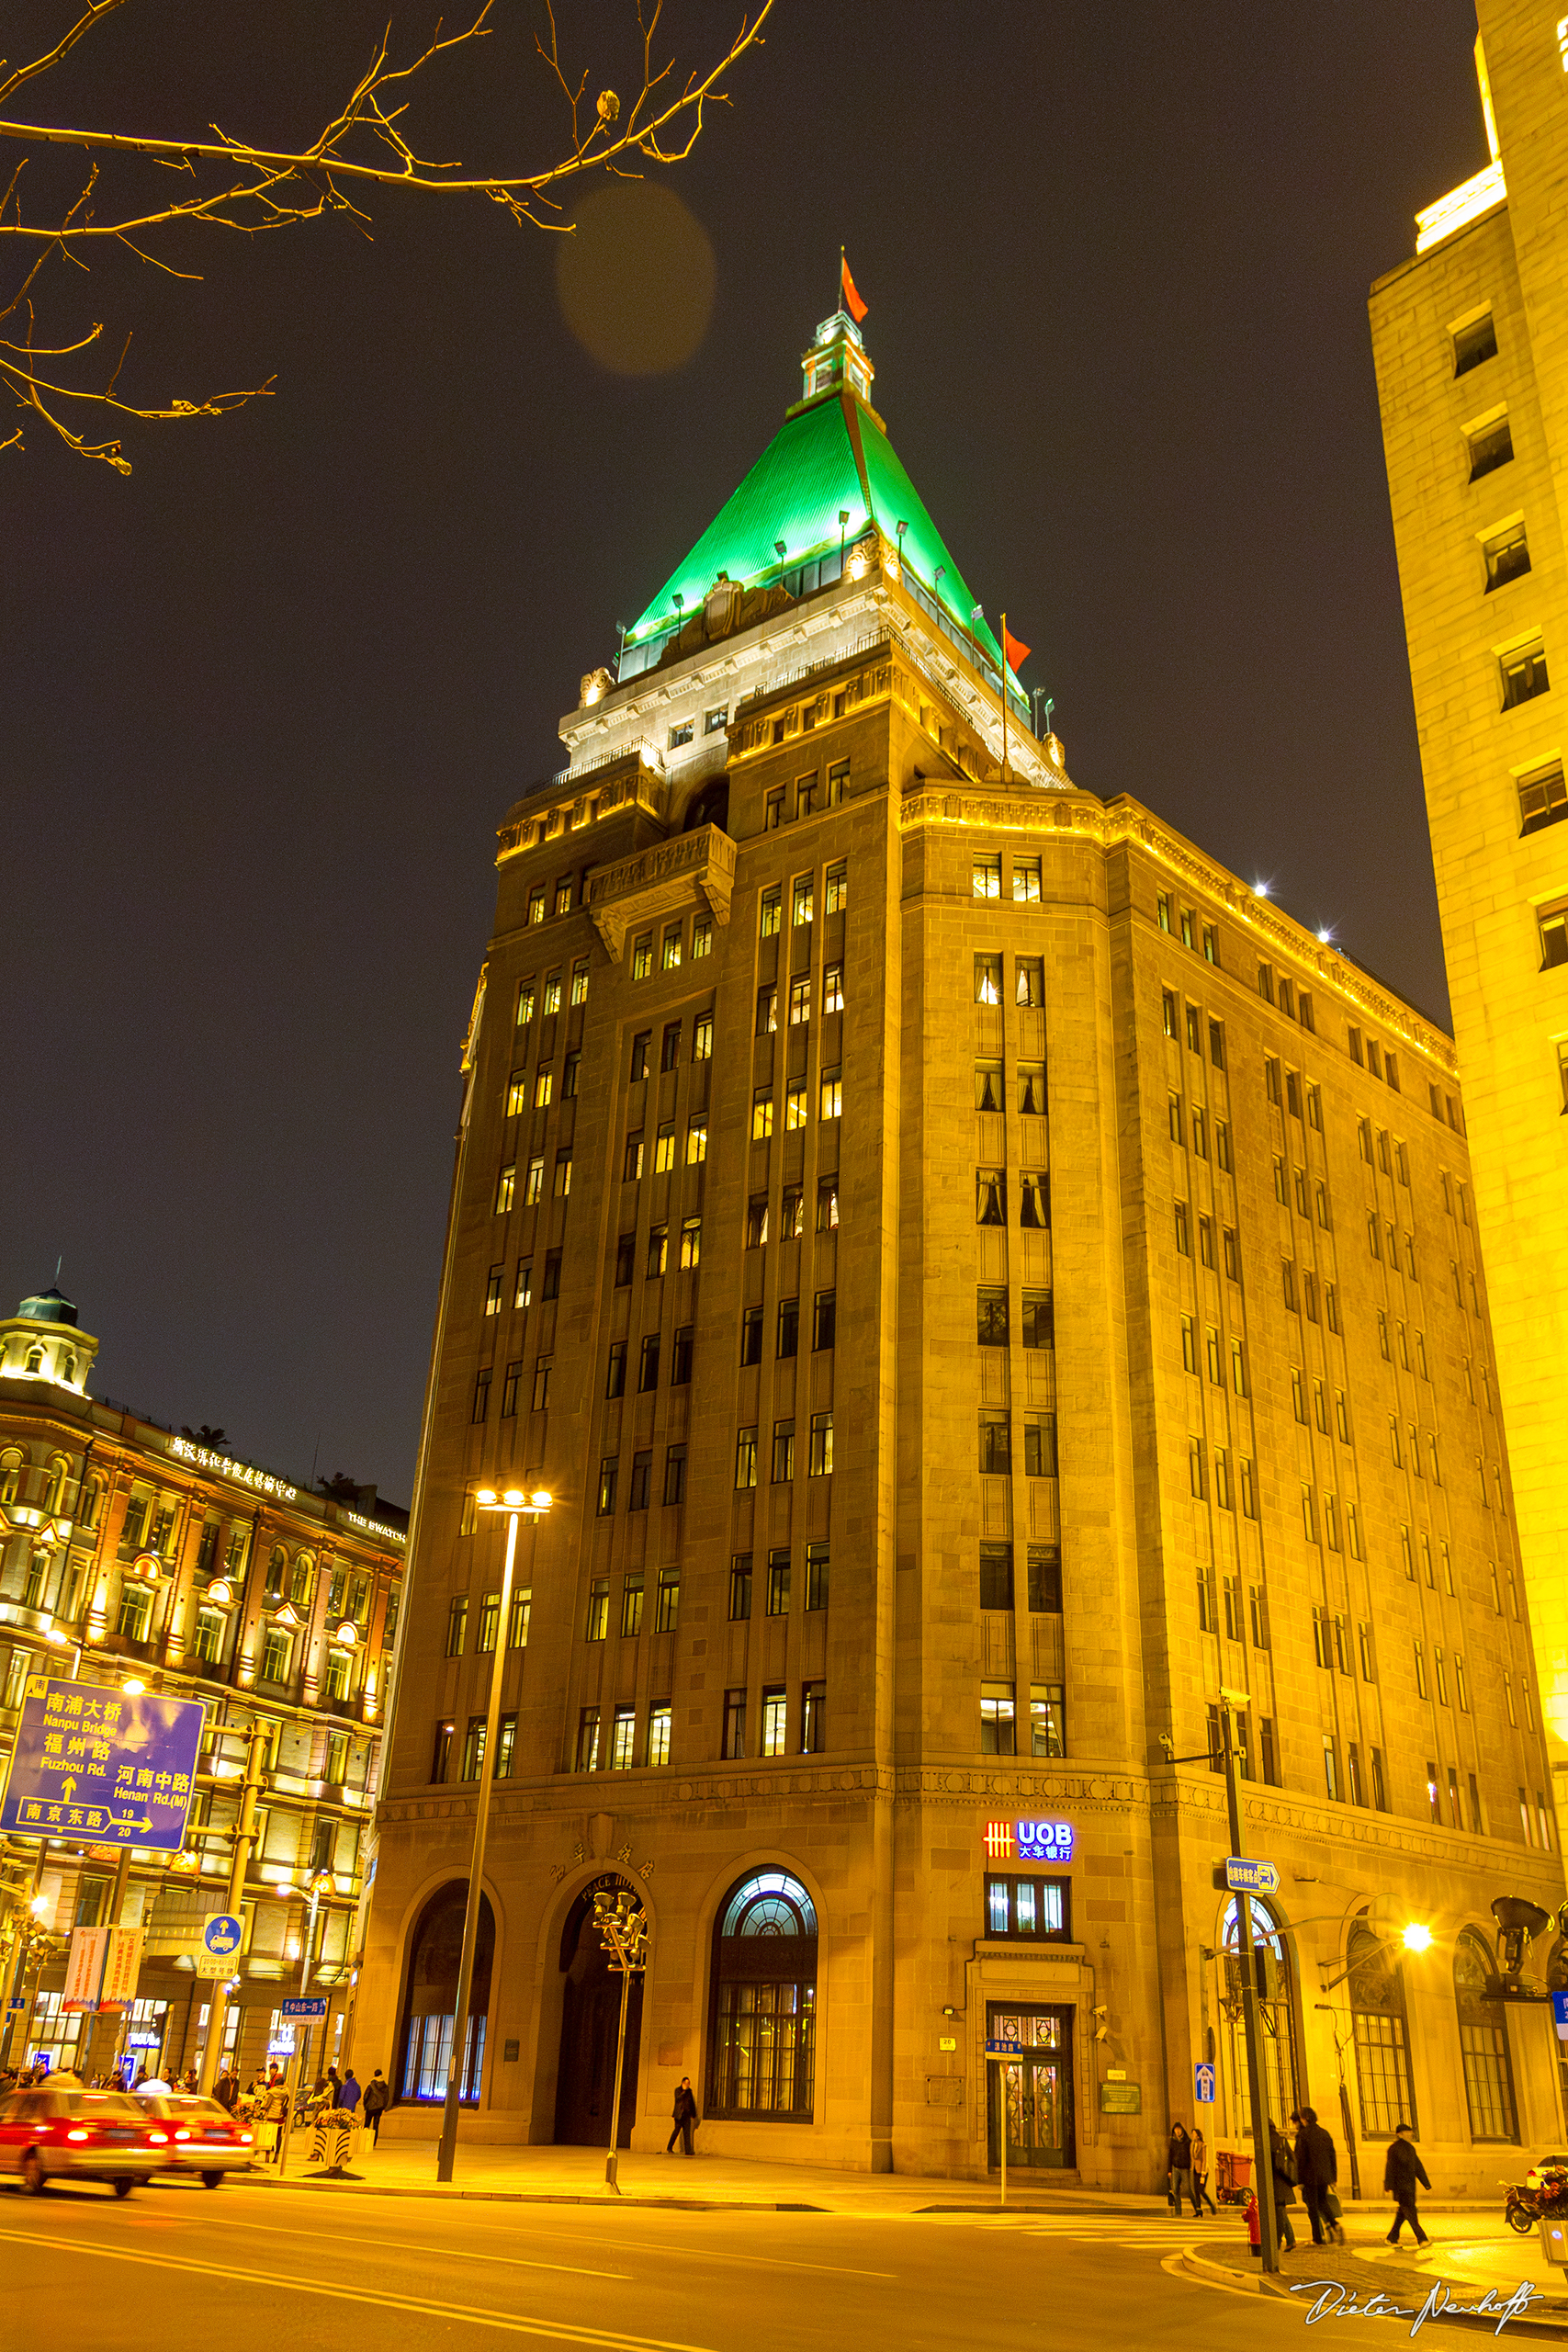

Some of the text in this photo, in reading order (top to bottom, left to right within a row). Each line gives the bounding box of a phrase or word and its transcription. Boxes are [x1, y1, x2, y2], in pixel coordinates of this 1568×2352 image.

[348, 1511, 406, 1544] THE SWATCH
[34, 1679, 45, 1690] 南
[46, 1692, 122, 1722] 南浦大桥
[43, 1714, 118, 1738] Nanpu Bridge
[44, 1733, 110, 1761] 福州路
[40, 1757, 107, 1777] Fuzhou Rd.
[116, 1765, 190, 1793] 河南中路
[114, 1786, 187, 1810] Henan Rd.(M)
[27, 1803, 103, 1827] 南京东路
[122, 1808, 133, 1818] 19
[118, 1826, 131, 1838] 20
[1018, 1822, 1072, 1846] UOB
[1019, 1845, 1071, 1860] 大华银行
[581, 1875, 611, 1901] PEACE
